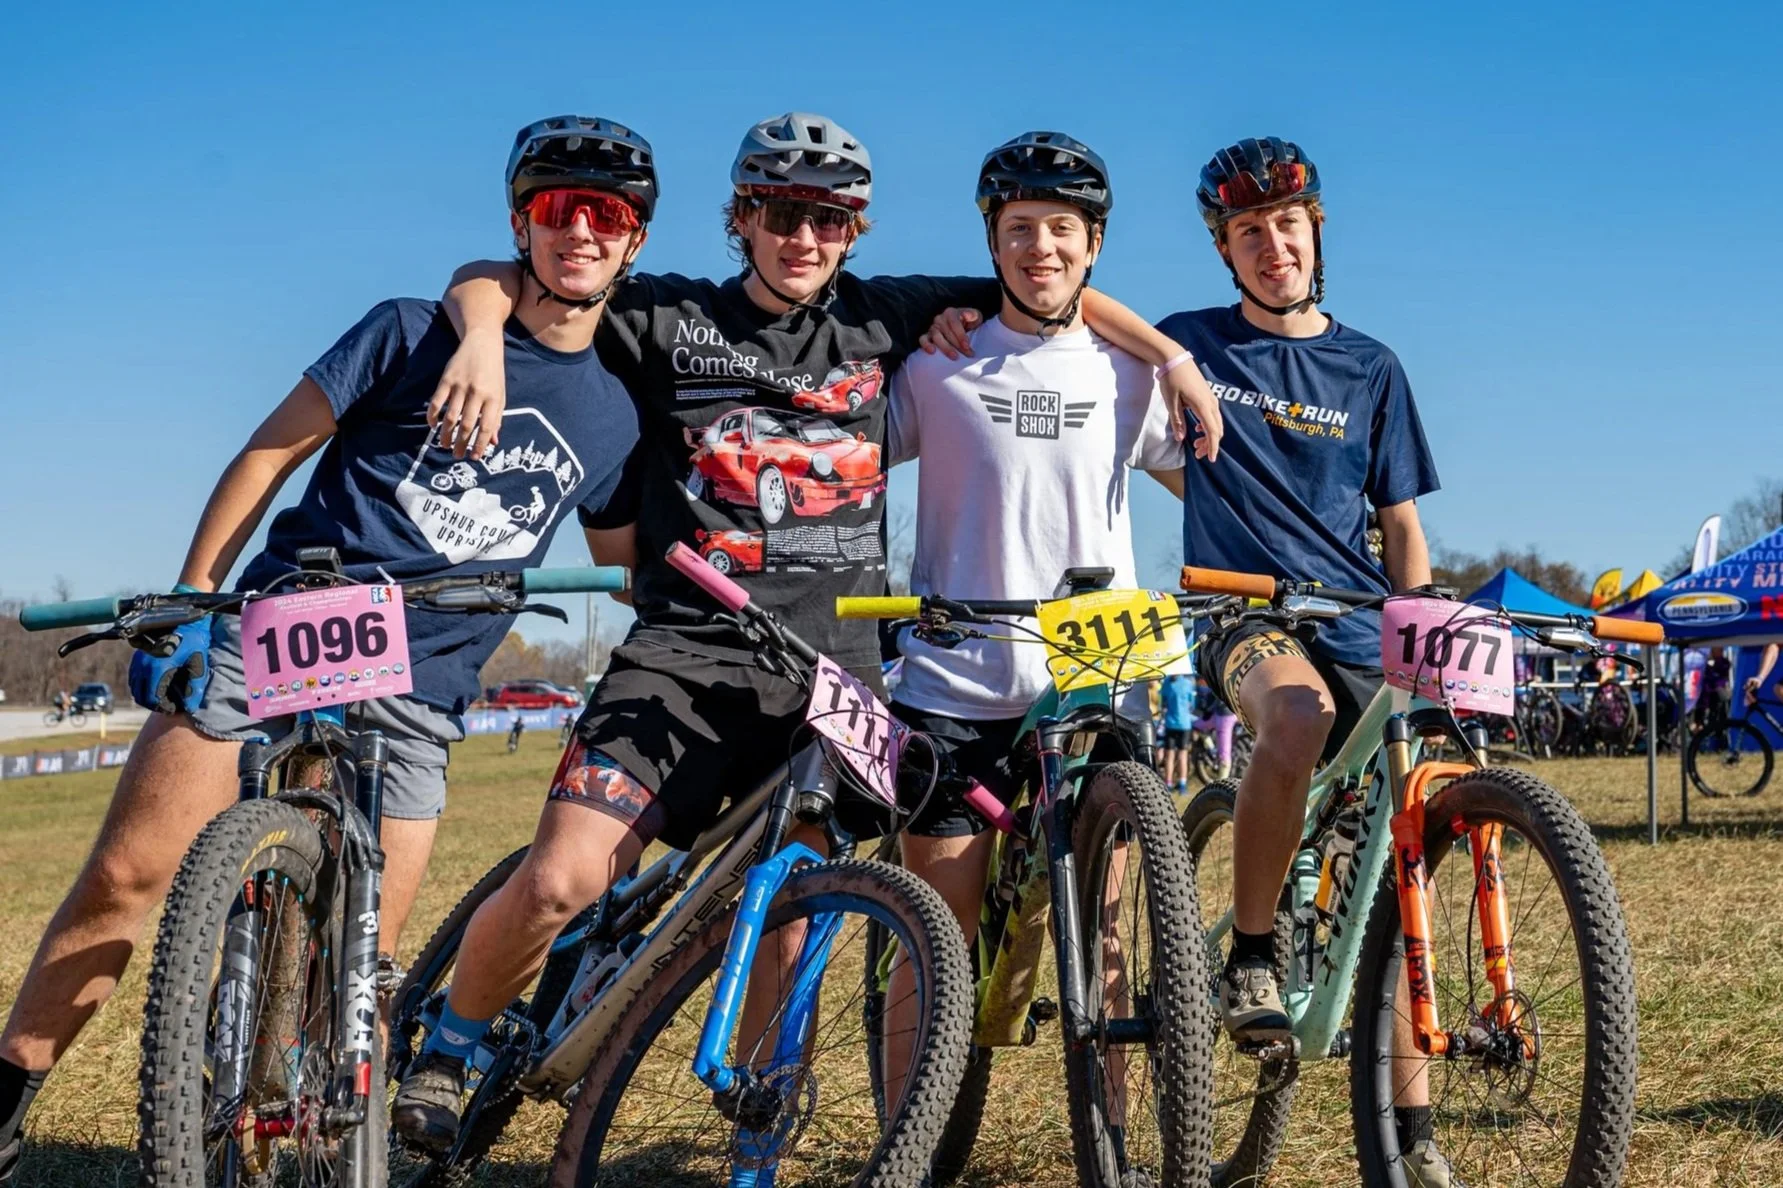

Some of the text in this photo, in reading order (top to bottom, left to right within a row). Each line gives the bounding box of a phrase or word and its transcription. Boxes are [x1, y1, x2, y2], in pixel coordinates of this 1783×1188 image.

[672, 347, 755, 379] Comes
[1021, 394, 1056, 413] ROCK
[1206, 380, 1241, 402] RO
[1020, 415, 1055, 435] SHOX
[1264, 411, 1345, 440] Pittsburgh, PA
[422, 497, 475, 533] UPSHUR
[1056, 606, 1166, 654] 3111
[1672, 603, 1733, 615] PENNSYLVANIA
[257, 611, 388, 675] 1096
[1397, 623, 1501, 676] 1077
[828, 680, 889, 768] 1111
[650, 838, 763, 969] INTENS
[1407, 955, 1431, 1004] FOX
[345, 970, 377, 1053] FOX
